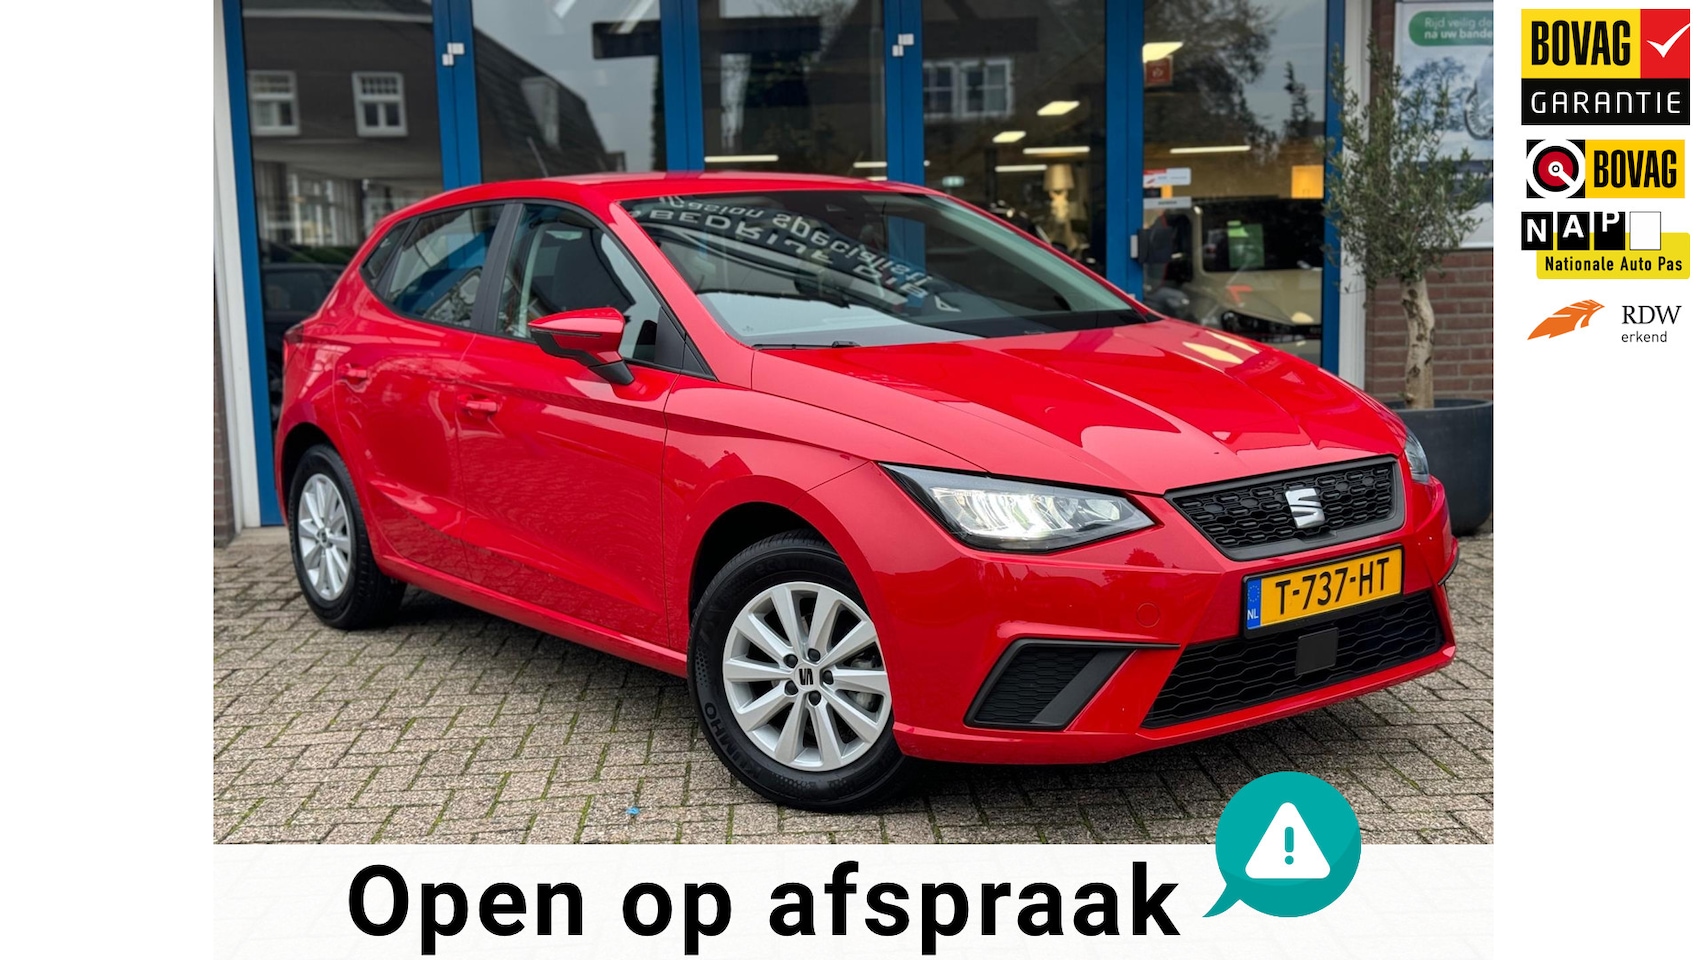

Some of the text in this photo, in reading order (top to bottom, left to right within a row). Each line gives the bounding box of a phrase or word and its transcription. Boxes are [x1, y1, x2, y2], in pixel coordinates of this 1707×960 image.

[1425, 17, 1446, 30] Rijd
[1424, 30, 1438, 39] na
[1440, 30, 1456, 39] uw
[1275, 557, 1390, 615] T-737-HT
[1247, 609, 1259, 620] NL
